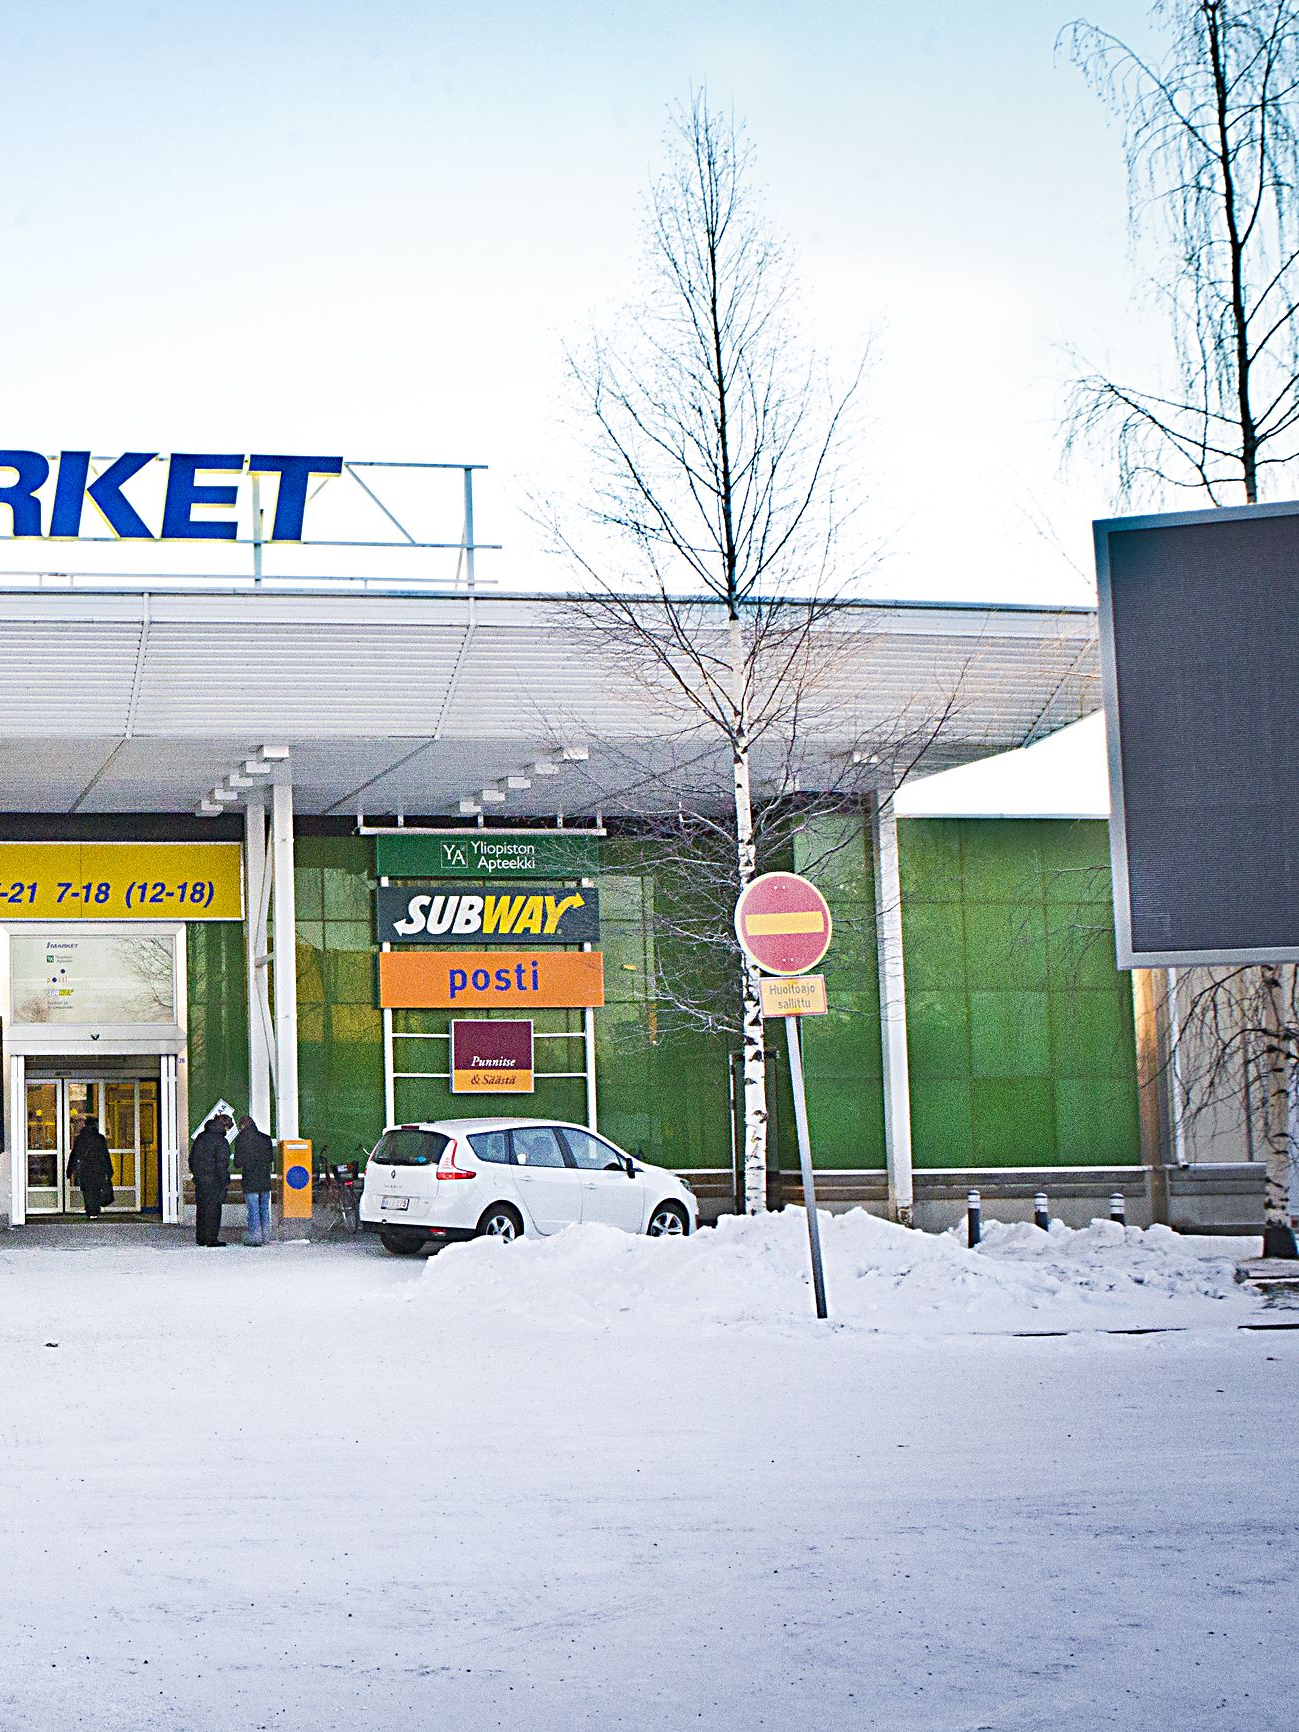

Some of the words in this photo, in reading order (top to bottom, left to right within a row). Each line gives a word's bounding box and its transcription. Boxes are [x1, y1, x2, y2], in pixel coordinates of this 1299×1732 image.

[470, 841, 535, 856] Yliopiston
[477, 857, 536, 872] Apteekki
[56, 882, 111, 904] 7-18
[125, 881, 215, 908] (12-18)
[393, 892, 585, 936] SUBWAY
[448, 960, 539, 999] posti
[769, 983, 816, 996] Huoltoajo
[777, 998, 812, 1010] sallittu
[470, 1055, 516, 1067] Punnitse
[481, 1073, 517, 1085] Säästä
